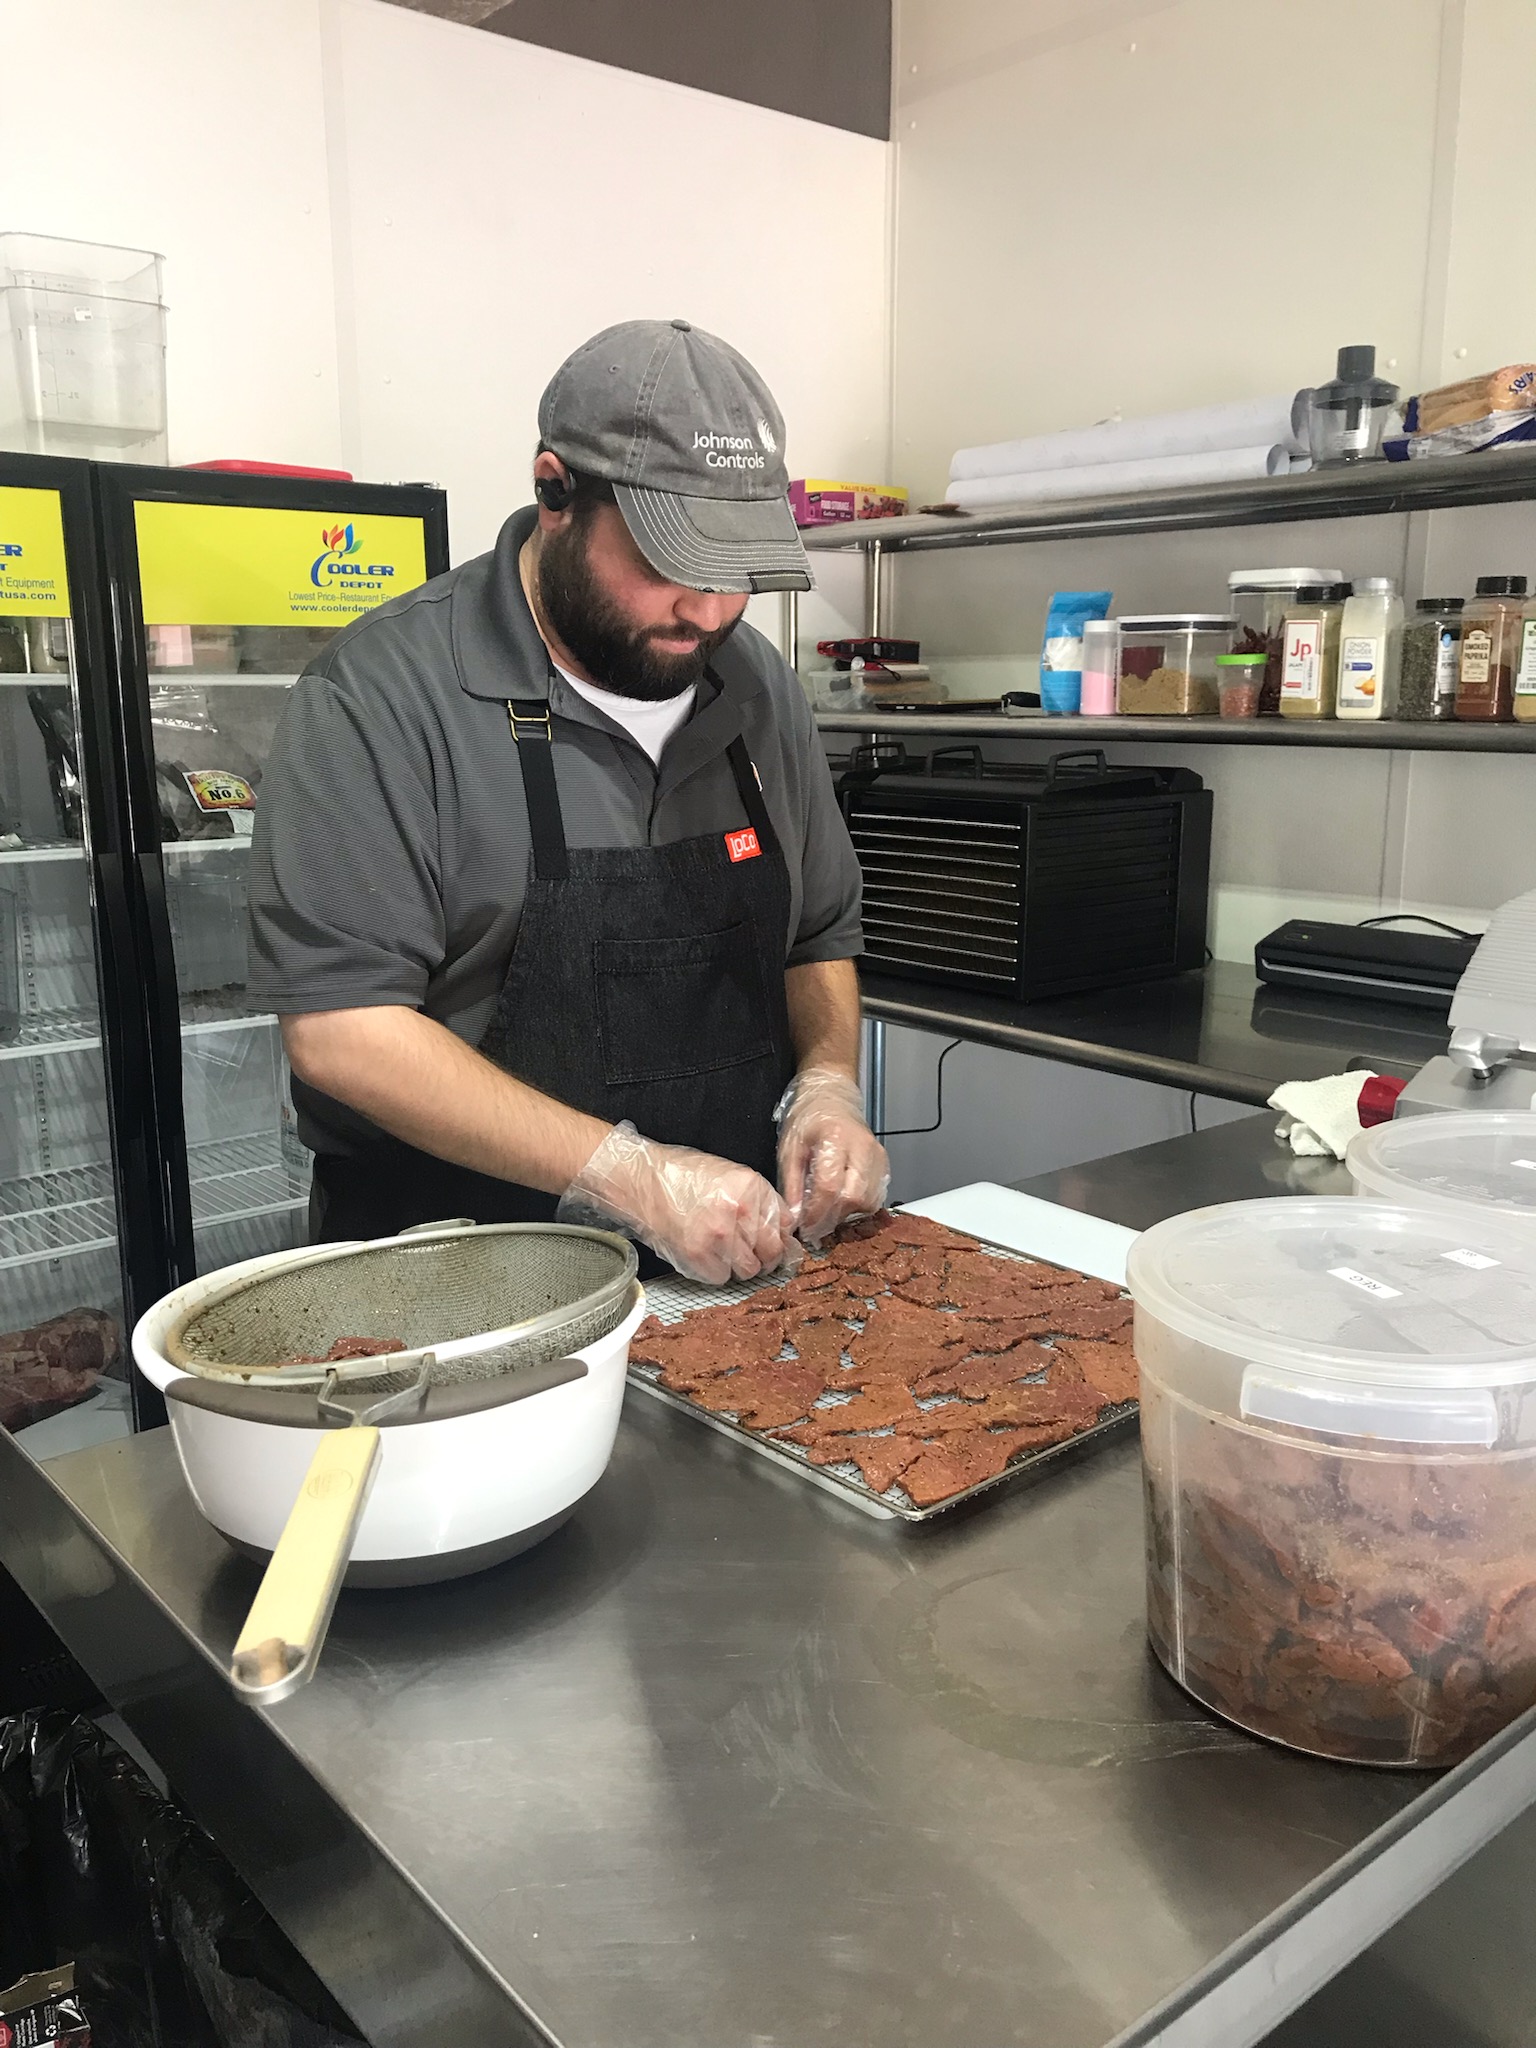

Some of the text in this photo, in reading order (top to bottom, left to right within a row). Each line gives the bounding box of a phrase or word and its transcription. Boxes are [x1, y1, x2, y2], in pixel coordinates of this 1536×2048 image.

[692, 431, 753, 450] Johnson
[705, 451, 765, 469] Controls
[6, 576, 55, 590] Equipment
[340, 581, 383, 589] DEPOT
[288, 591, 316, 601] Lowest
[1290, 638, 1312, 661] Jp
[1349, 1275, 1382, 1291] REG
